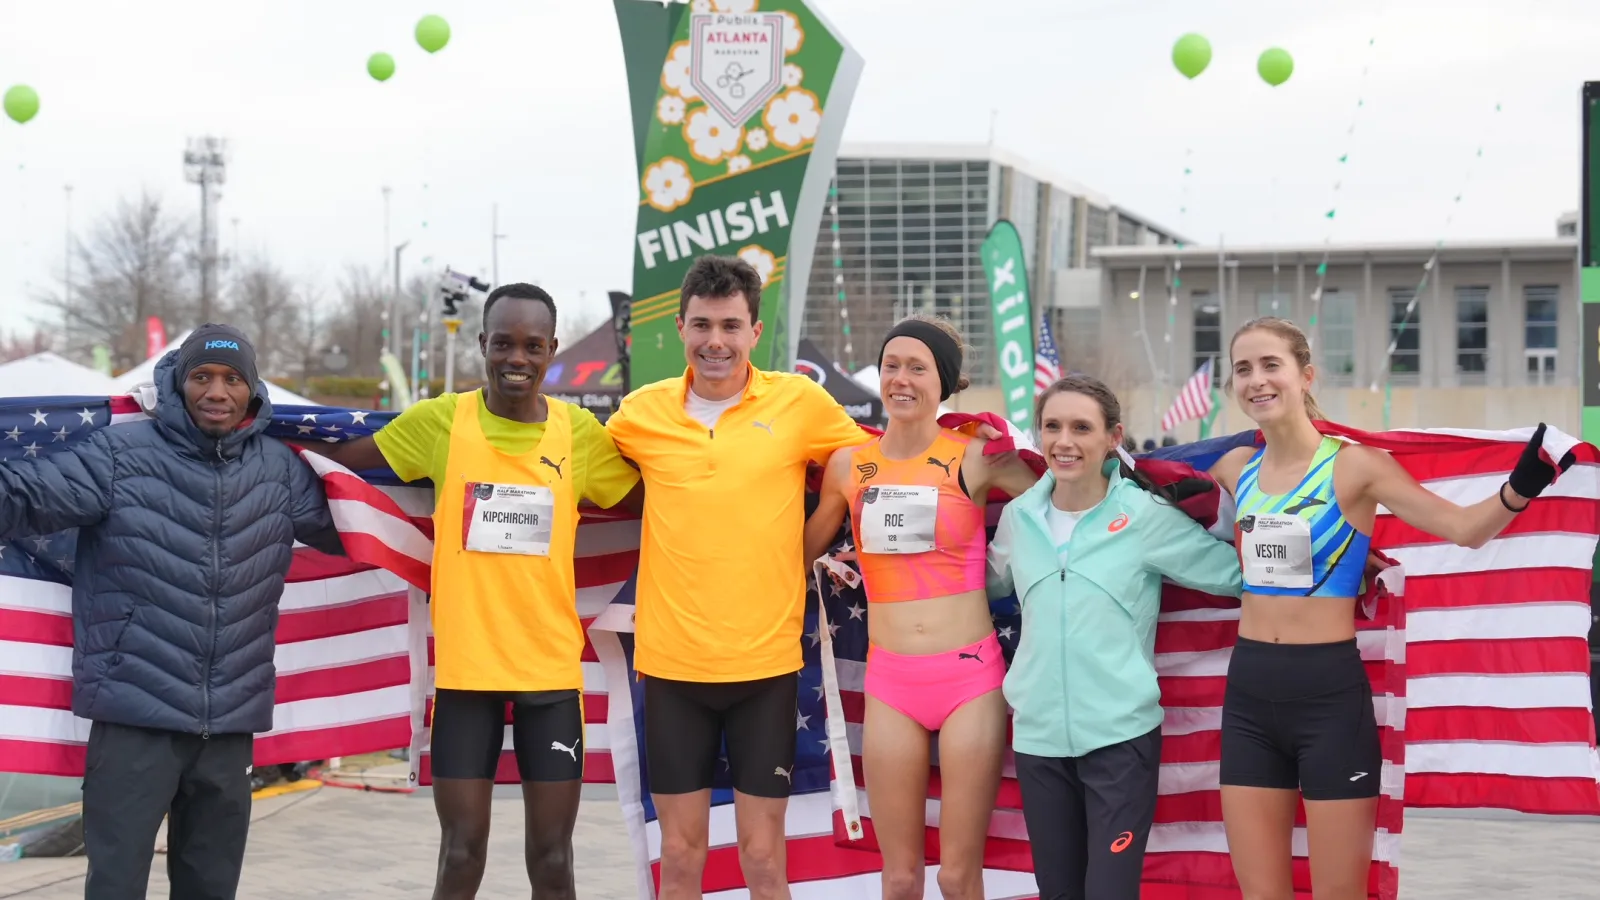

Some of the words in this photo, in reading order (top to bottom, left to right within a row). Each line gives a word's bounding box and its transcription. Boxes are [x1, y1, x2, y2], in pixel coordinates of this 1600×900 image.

[706, 32, 768, 43] ATLANTA
[637, 190, 790, 270] FINISH
[204, 340, 239, 351] HOKA
[482, 510, 539, 525] KIPCHIRCHIR
[884, 513, 904, 527] ROE
[504, 532, 512, 540] 21
[1255, 543, 1287, 559] VESTRI
[1265, 566, 1274, 574] 137
